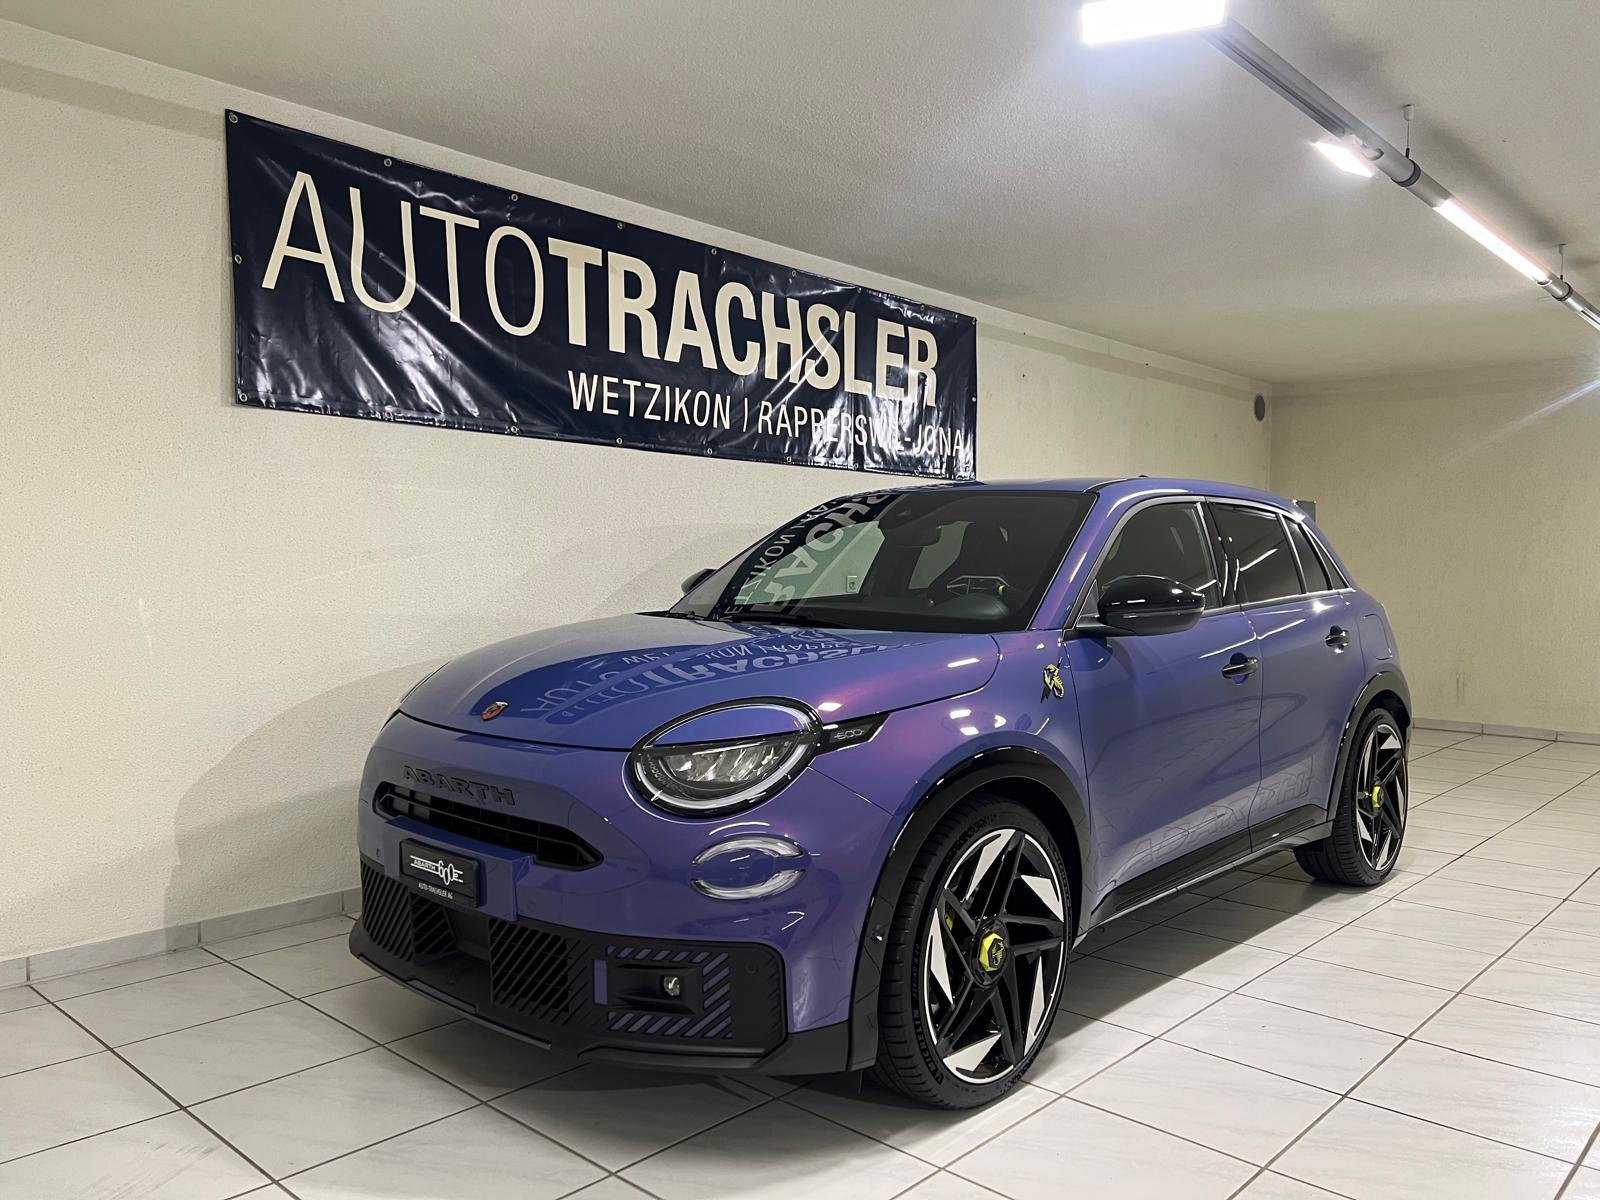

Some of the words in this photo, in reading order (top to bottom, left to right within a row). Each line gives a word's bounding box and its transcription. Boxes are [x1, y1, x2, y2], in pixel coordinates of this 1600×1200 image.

[568, 370, 732, 430] WETZIKON
[403, 765, 516, 807] ABARTH
[413, 859, 436, 871] ABARTH
